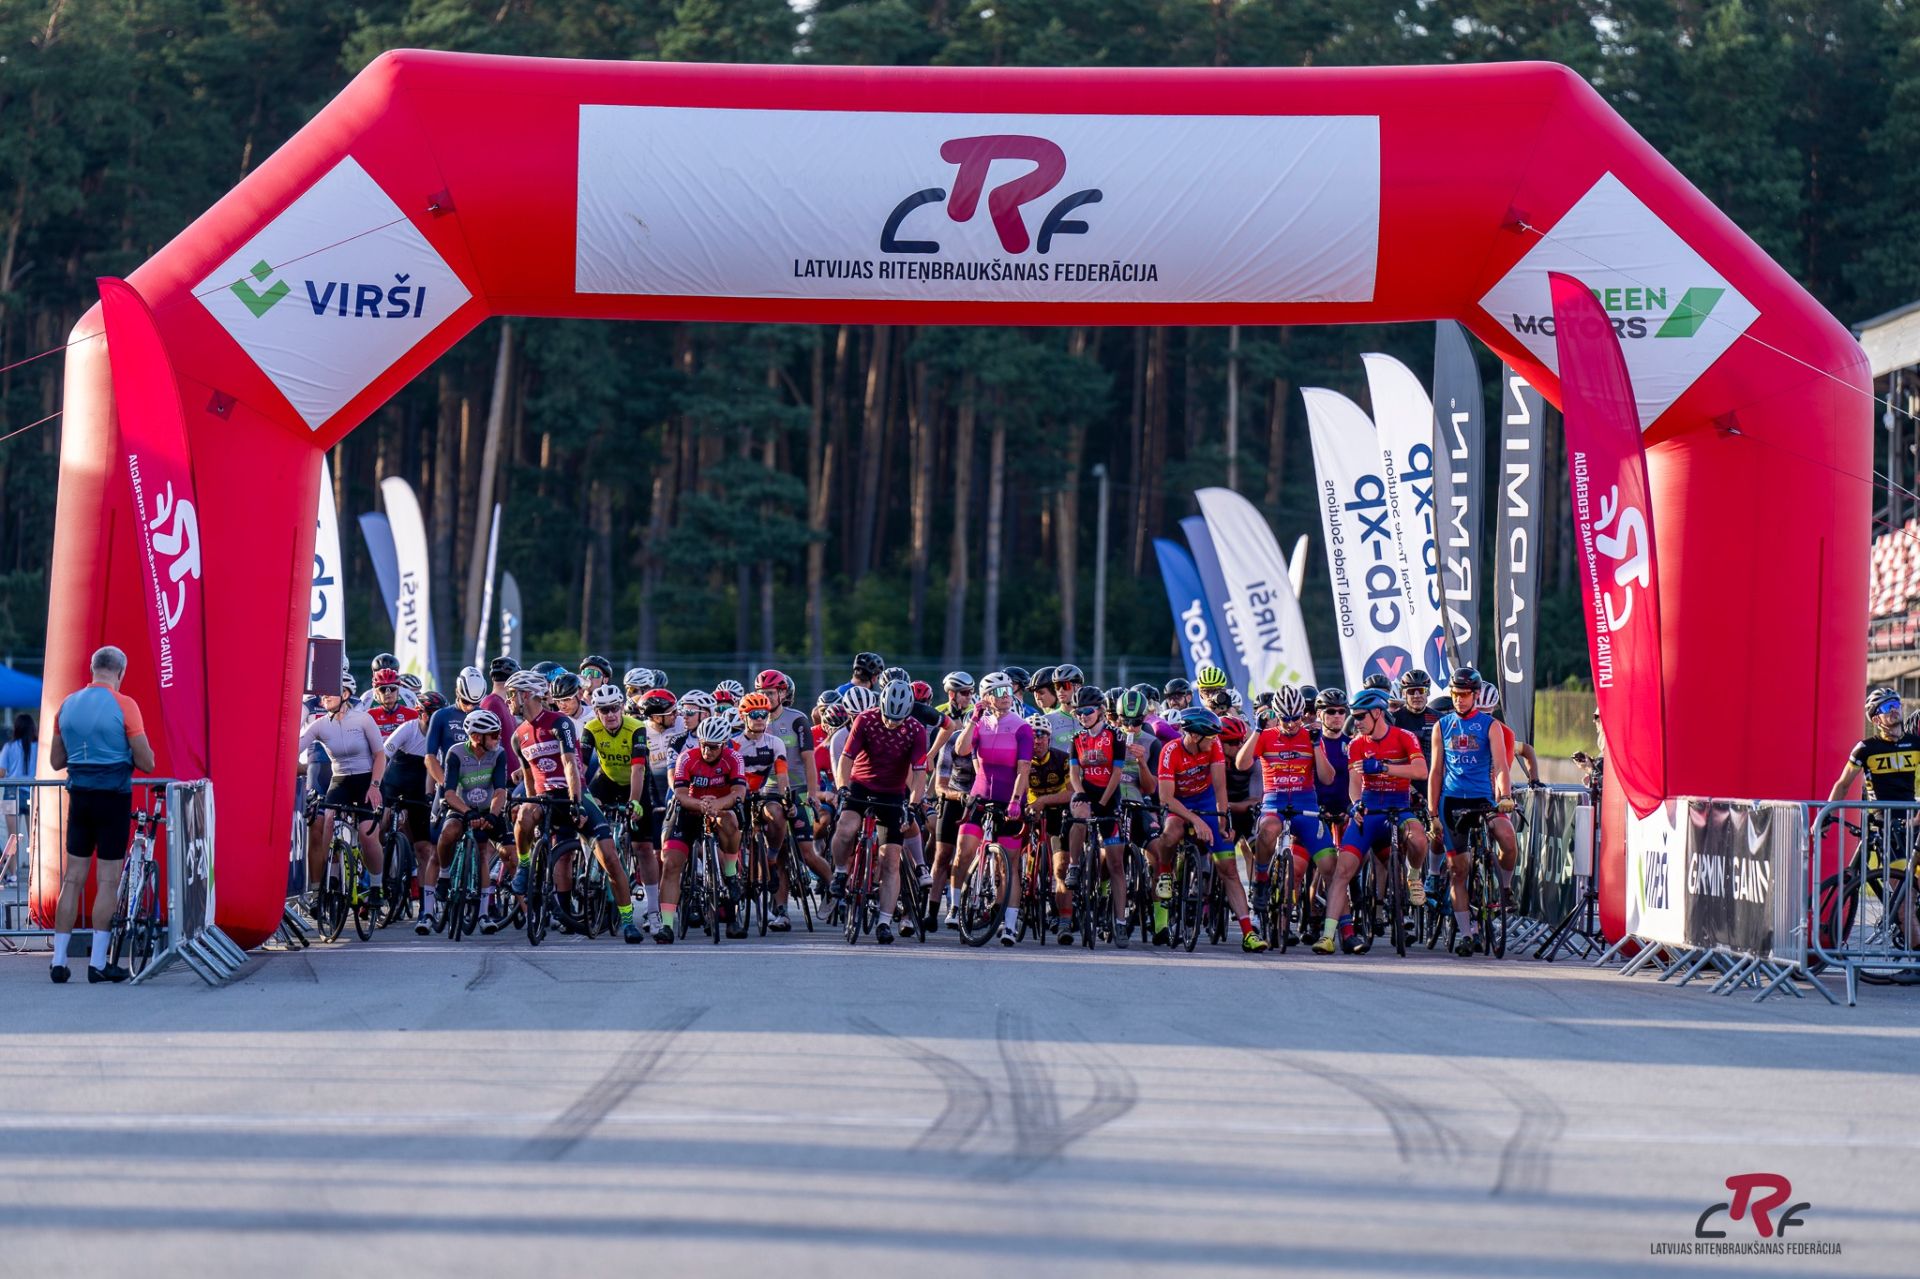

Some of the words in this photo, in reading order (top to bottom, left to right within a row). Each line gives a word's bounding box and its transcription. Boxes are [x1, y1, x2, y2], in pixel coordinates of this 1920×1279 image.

[794, 258, 874, 278] LATVIJAS
[879, 257, 1051, 285] RITEŅBRAUKŠANAS
[1054, 259, 1158, 282] FEDERĀCIJA
[304, 273, 426, 319] VIRŠI
[1687, 852, 1726, 899] GARMIN
